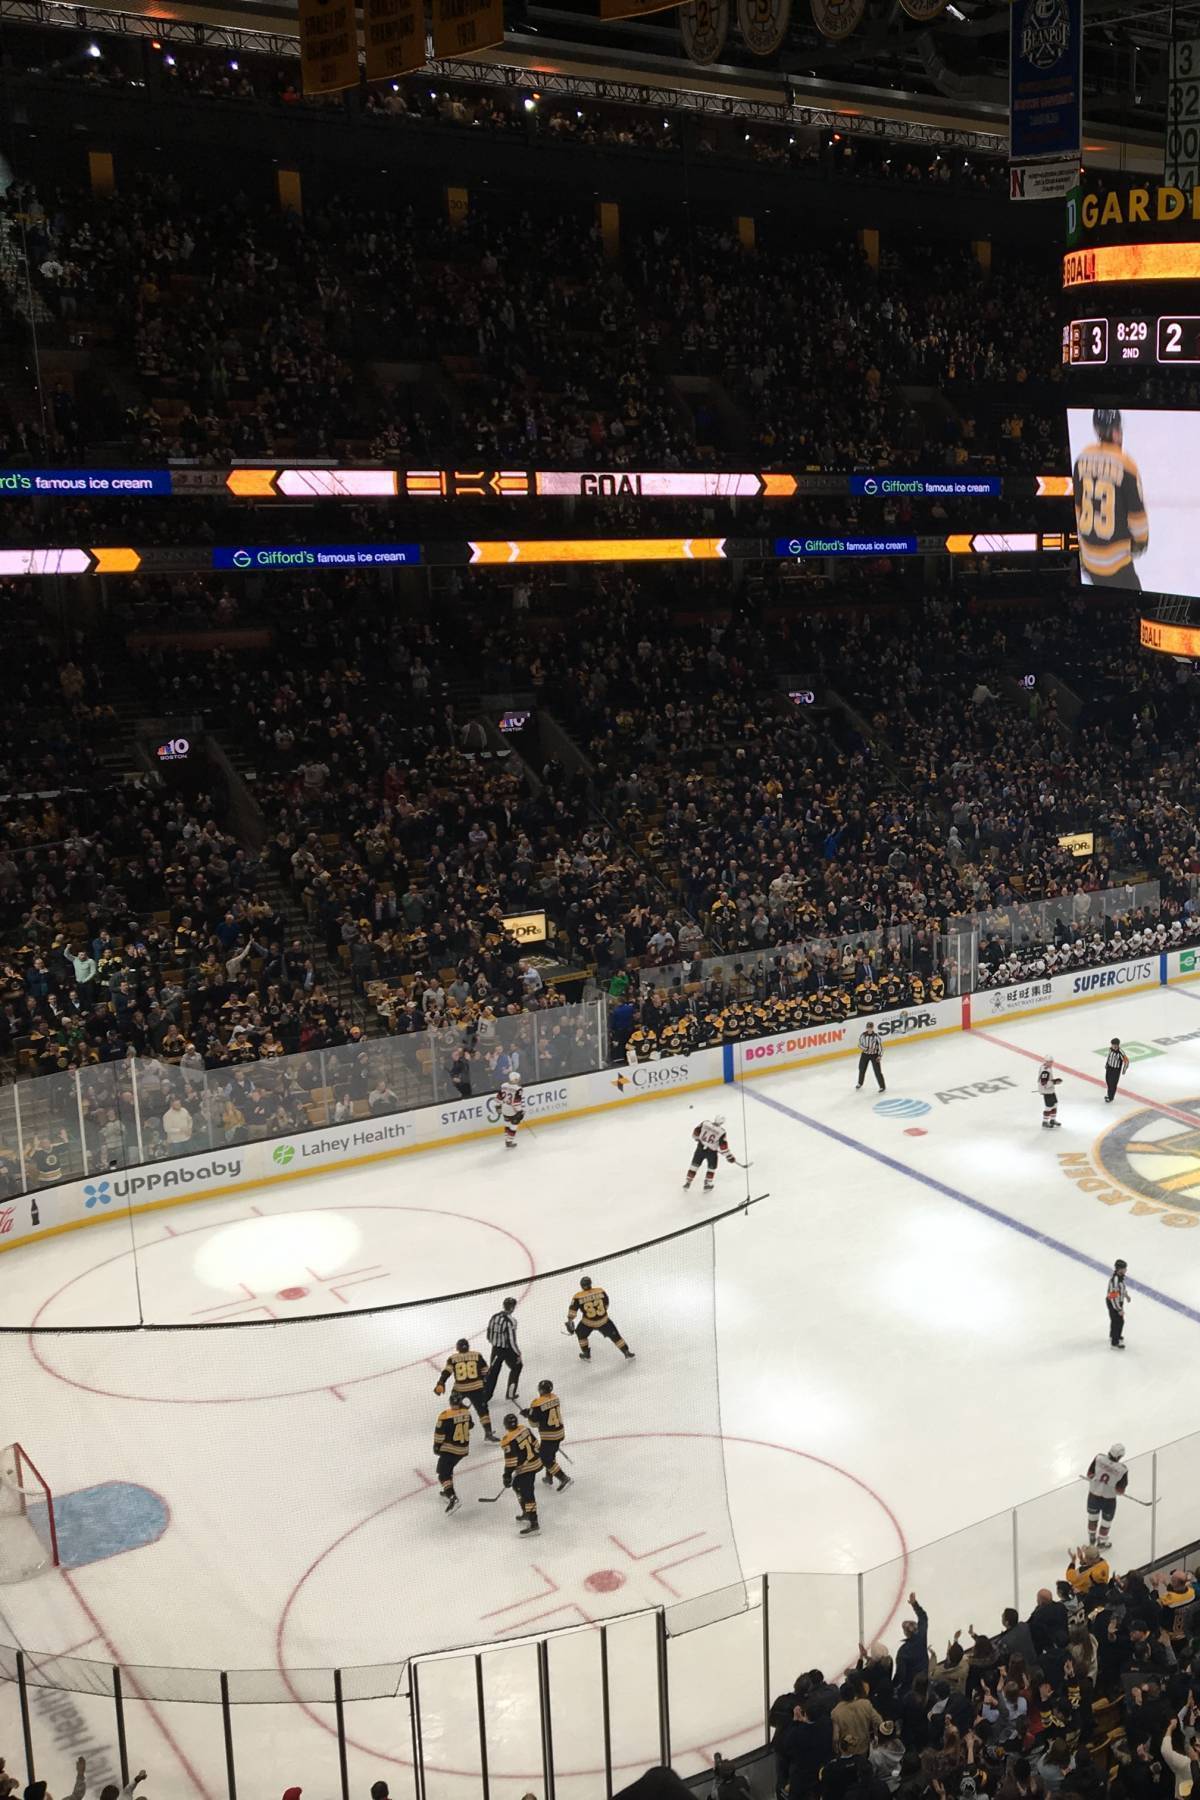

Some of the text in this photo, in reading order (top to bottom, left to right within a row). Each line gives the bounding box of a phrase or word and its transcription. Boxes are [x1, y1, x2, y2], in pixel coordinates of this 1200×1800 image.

[1023, 24, 1069, 55] BEANPOT
[1180, 45, 1192, 74] 3
[1168, 128, 1198, 159] 00
[1067, 253, 1095, 285] GOAL!
[1092, 326, 1102, 355] 3
[1117, 322, 1147, 341] 8:29
[1166, 323, 1182, 352] 2
[1122, 347, 1140, 359] 2ND
[35, 477, 86, 489] famous
[88, 477, 109, 489] ice
[111, 478, 152, 489] cream
[881, 482, 990, 493] Gifford's famous ice cream
[257, 551, 406, 564] Gifford's famous ice cream
[805, 541, 908, 551] Gifford's famous ice cream
[1024, 674, 1036, 686] 10
[167, 738, 189, 754] 10
[1072, 964, 1152, 994] SUPERCUTS
[745, 1028, 847, 1060] BOS DUNKIN'
[934, 1076, 1018, 1104] AT&T
[441, 1105, 483, 1125] STATE
[301, 1123, 405, 1158] Lahey Health
[113, 1159, 243, 1198] UPPAbaby
[1057, 1151, 1199, 1228] GARDEN
[455, 1361, 478, 1382] 88
